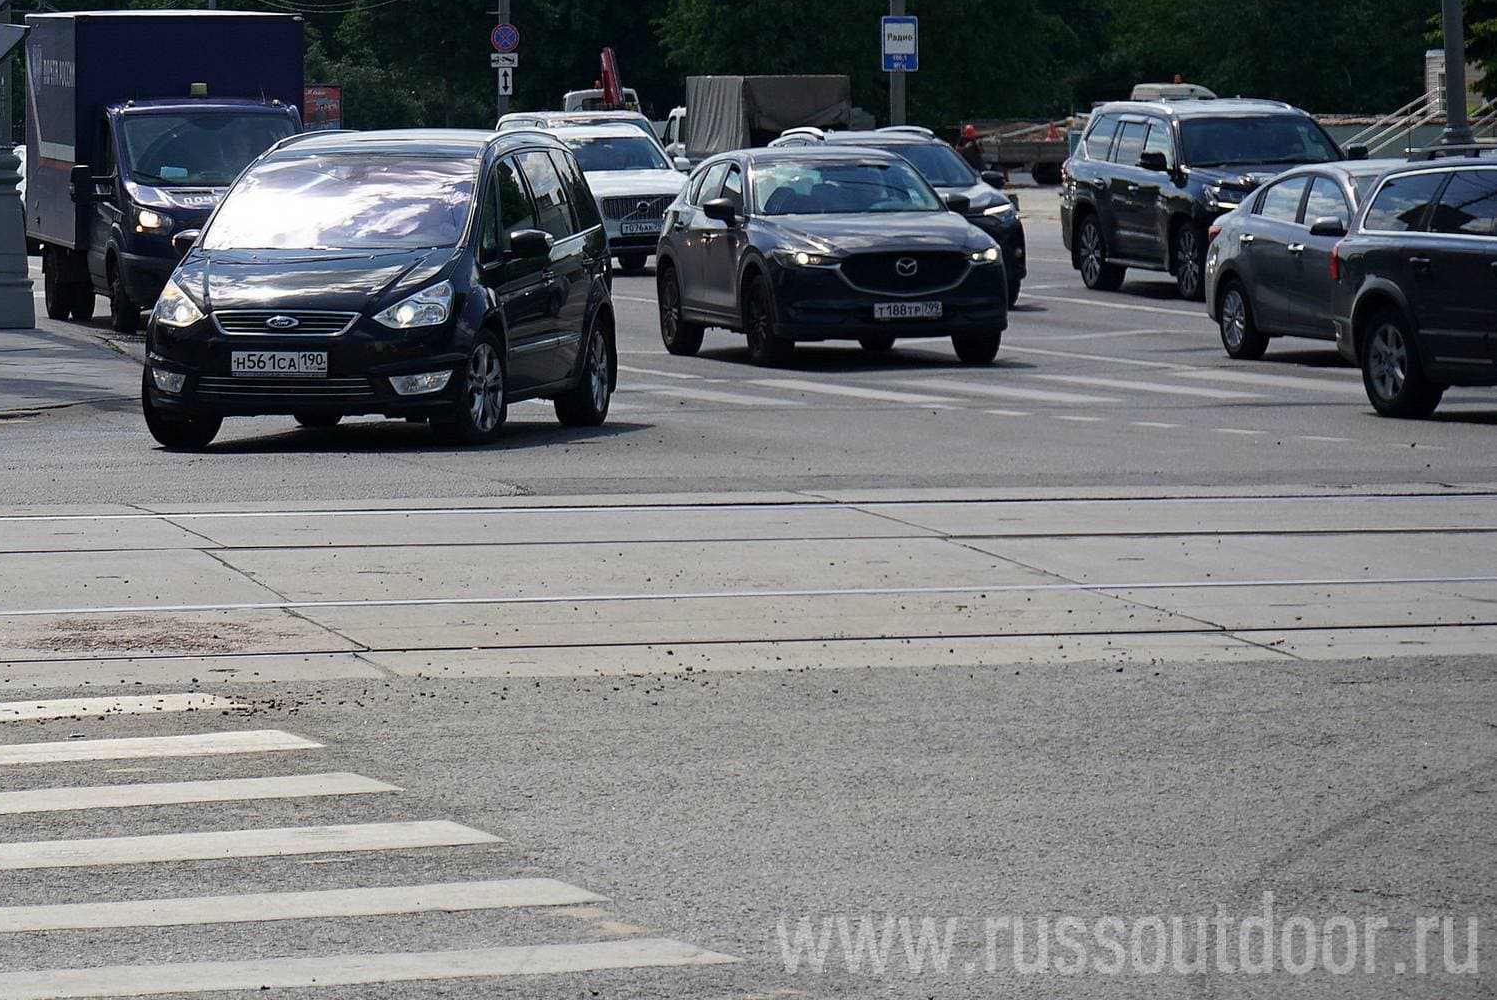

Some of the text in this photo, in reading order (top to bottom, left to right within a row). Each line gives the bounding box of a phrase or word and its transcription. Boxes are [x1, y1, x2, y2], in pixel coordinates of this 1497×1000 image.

[887, 33, 913, 43] Радио
[184, 195, 223, 204] ПОЧТ
[236, 353, 323, 370] Н561СА 190
